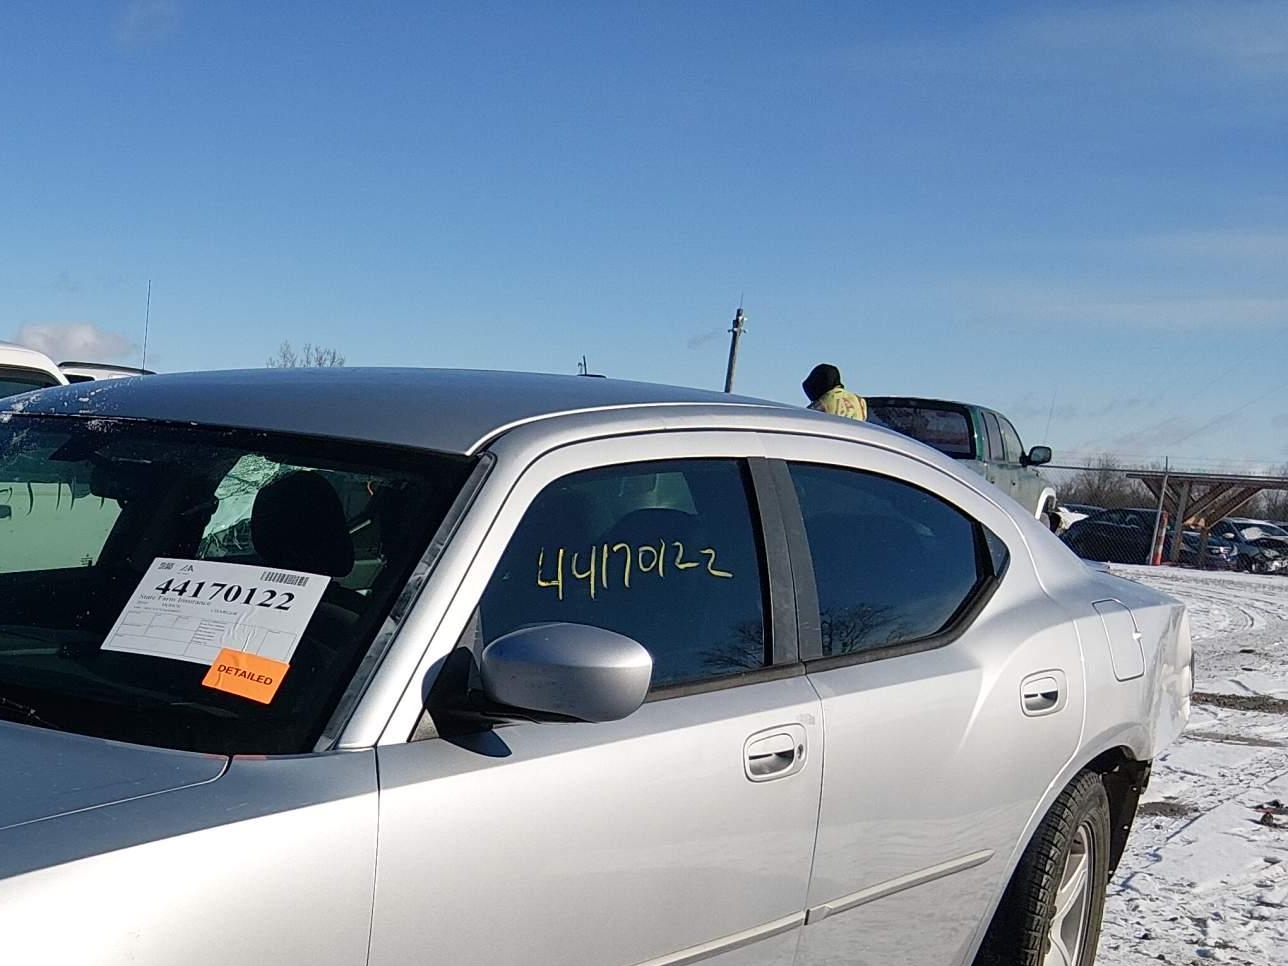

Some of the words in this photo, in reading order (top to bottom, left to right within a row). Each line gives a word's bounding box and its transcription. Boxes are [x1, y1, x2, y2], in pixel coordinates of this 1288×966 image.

[537, 538, 734, 600] 44170122
[155, 578, 295, 611] 44170122
[158, 595, 176, 603] Farm
[217, 664, 273, 686] DETAILED
